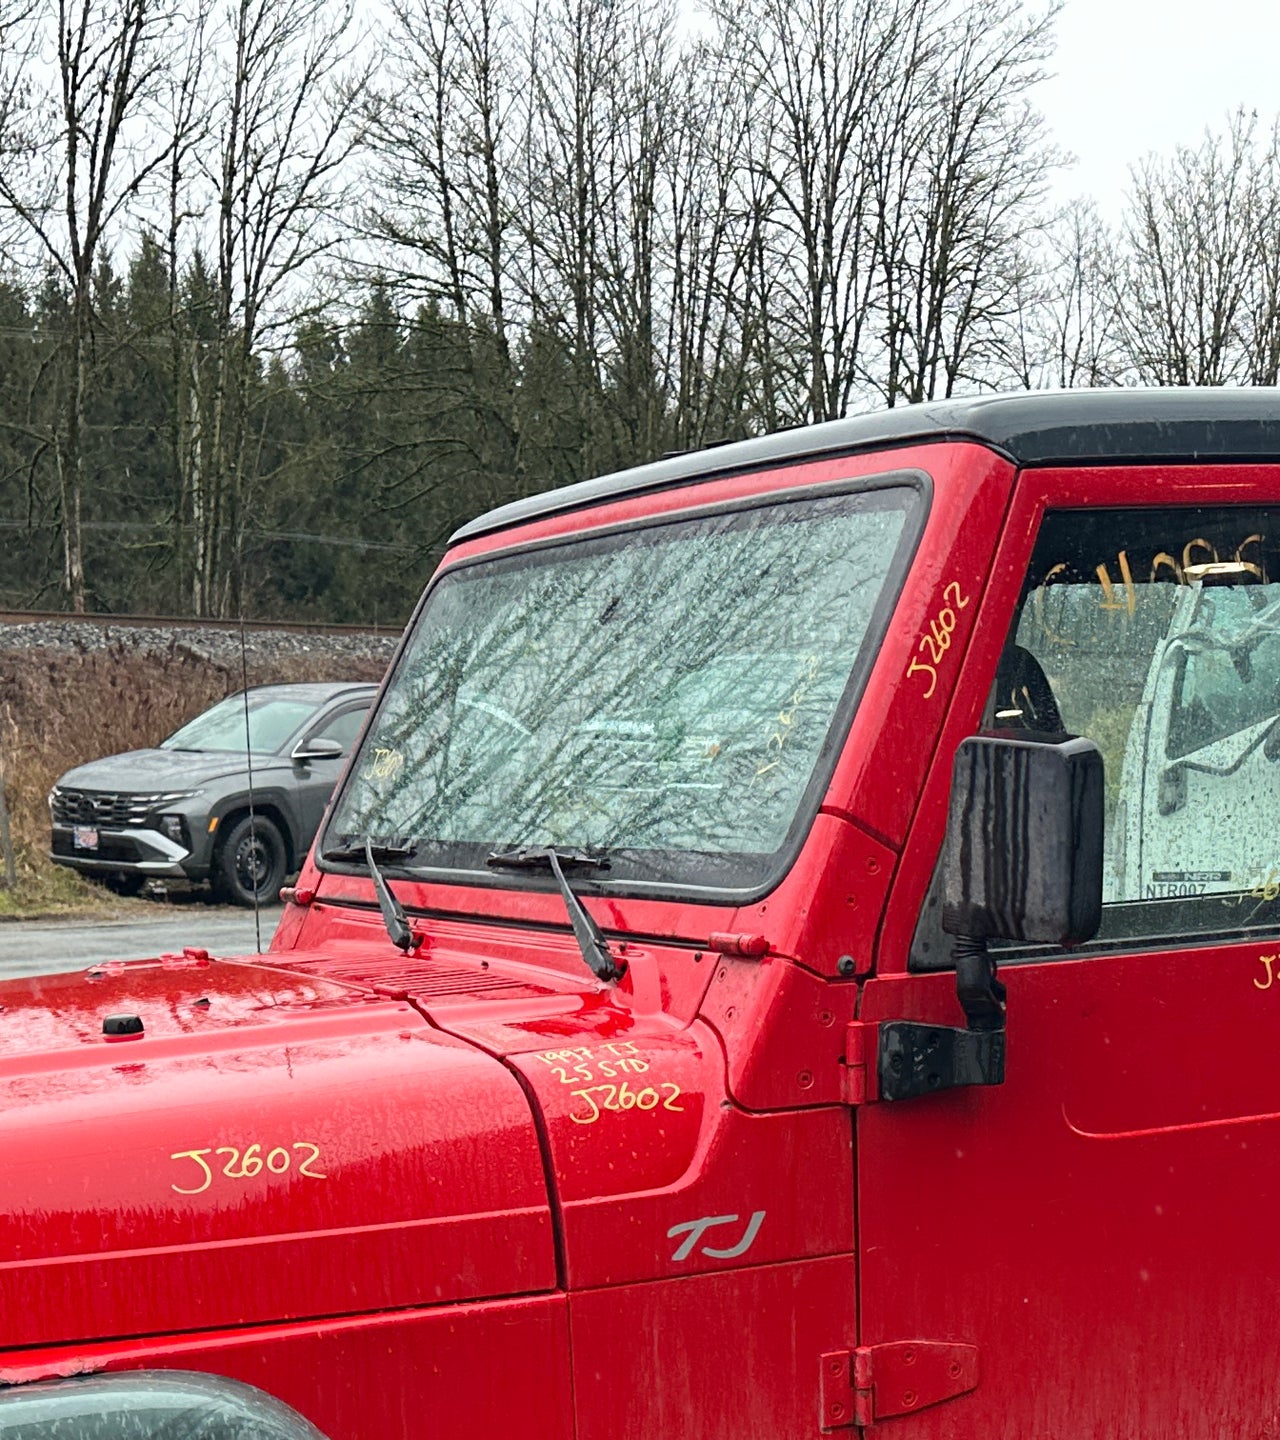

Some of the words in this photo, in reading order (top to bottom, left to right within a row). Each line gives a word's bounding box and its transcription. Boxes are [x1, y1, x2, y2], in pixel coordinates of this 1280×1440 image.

[906, 581, 969, 699] J2602
[534, 1046, 595, 1065] 1997
[599, 1040, 640, 1056] TJ
[597, 1058, 650, 1077] STD
[570, 1081, 685, 1124] J2602
[171, 1143, 327, 1194] J2602
[667, 1210, 766, 1261] TJ
